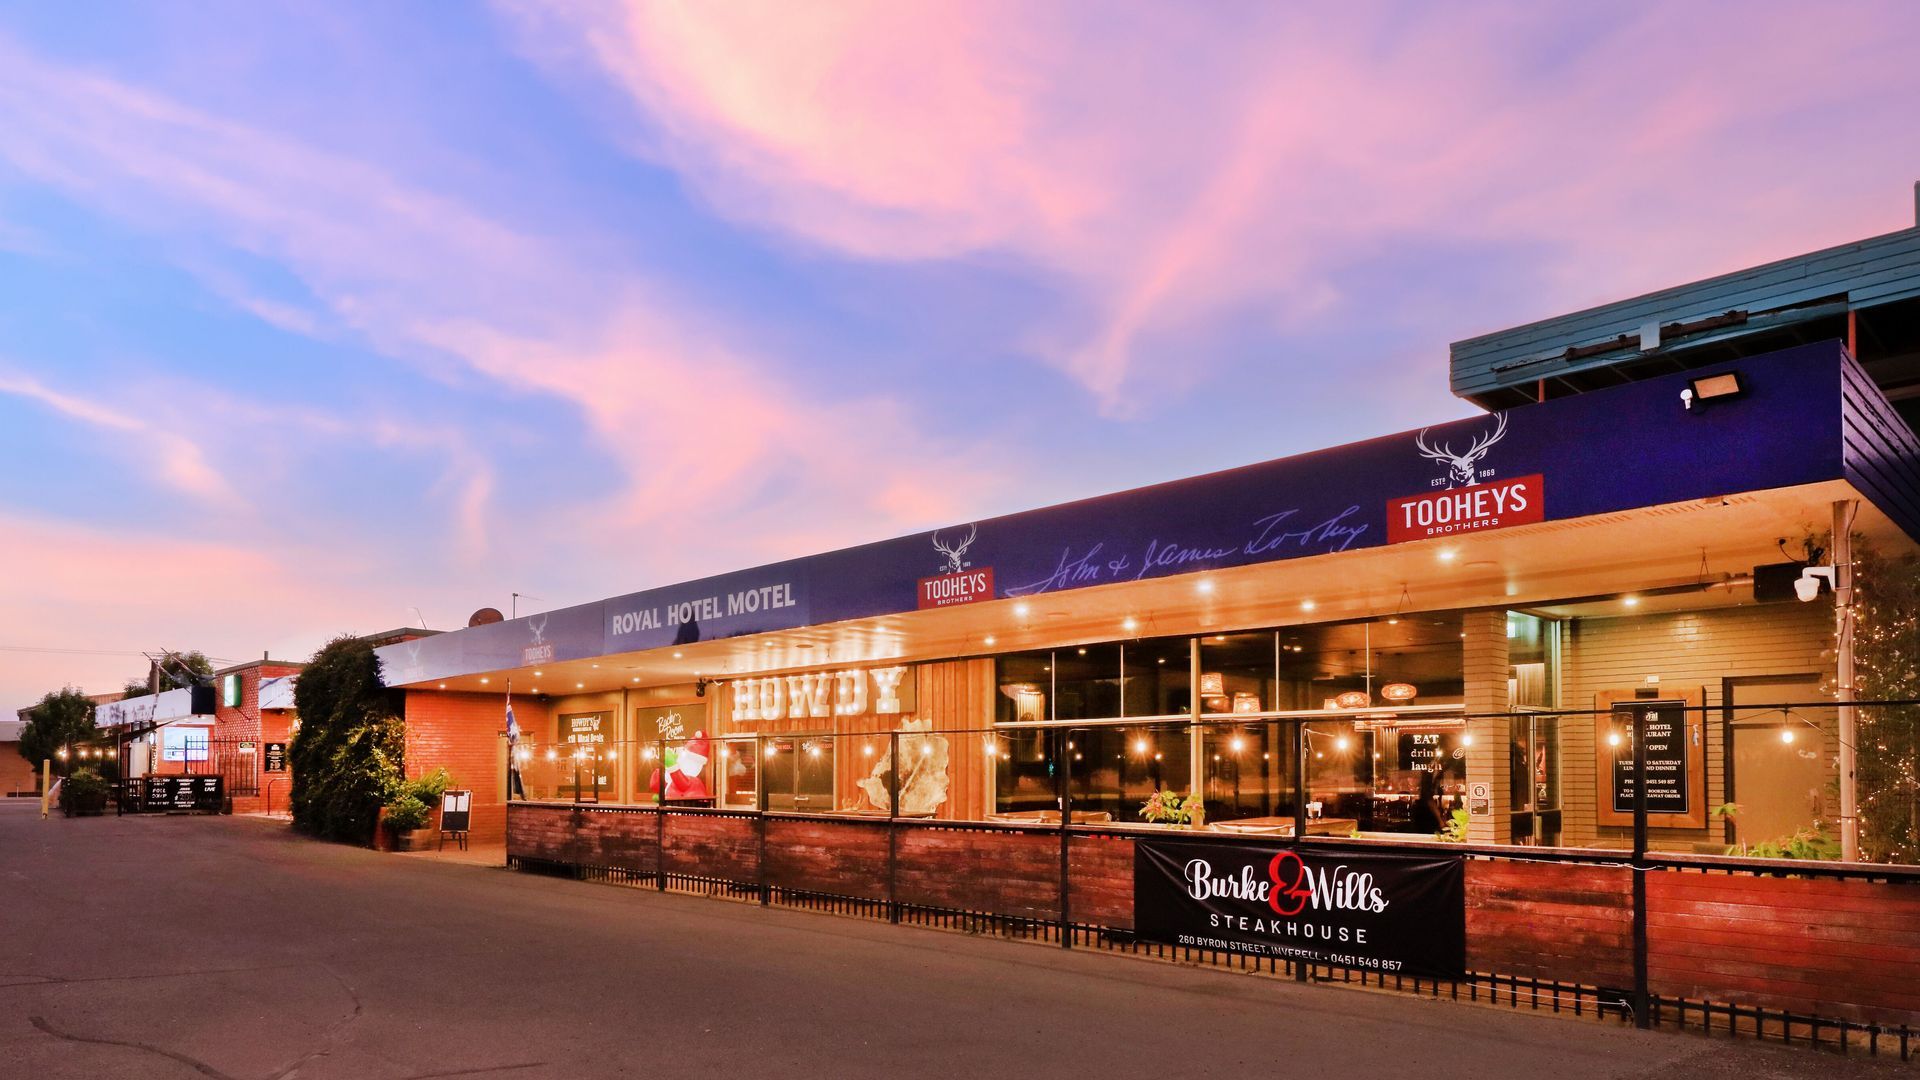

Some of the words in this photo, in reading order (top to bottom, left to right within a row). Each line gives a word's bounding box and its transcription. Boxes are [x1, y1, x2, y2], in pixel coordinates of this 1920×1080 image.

[1479, 468, 1495, 478] 1869
[1401, 483, 1527, 529] TOOHEYS
[1427, 518, 1499, 535] BROTHERS
[1136, 539, 1238, 580] James
[924, 572, 986, 600] TOOHEYS
[937, 595, 973, 605] BROTHERS
[612, 608, 661, 636] ROYAL
[667, 596, 723, 626] HOTEL
[727, 583, 796, 616] MOTEL
[732, 666, 908, 722] HOWDY
[1412, 734, 1439, 745] EAT
[1411, 761, 1442, 773] laugh
[1184, 858, 1270, 902] Burke
[1268, 851, 1314, 916] &
[1302, 865, 1390, 914] Wills
[1210, 913, 1367, 944] STEAKHOUSE
[1178, 934, 1195, 945] 260
[1196, 936, 1228, 949] BYRON
[1270, 946, 1322, 961] INVERELL
[1330, 953, 1356, 965] 0451
[1358, 956, 1379, 968] 549
[1382, 959, 1402, 971] 857
